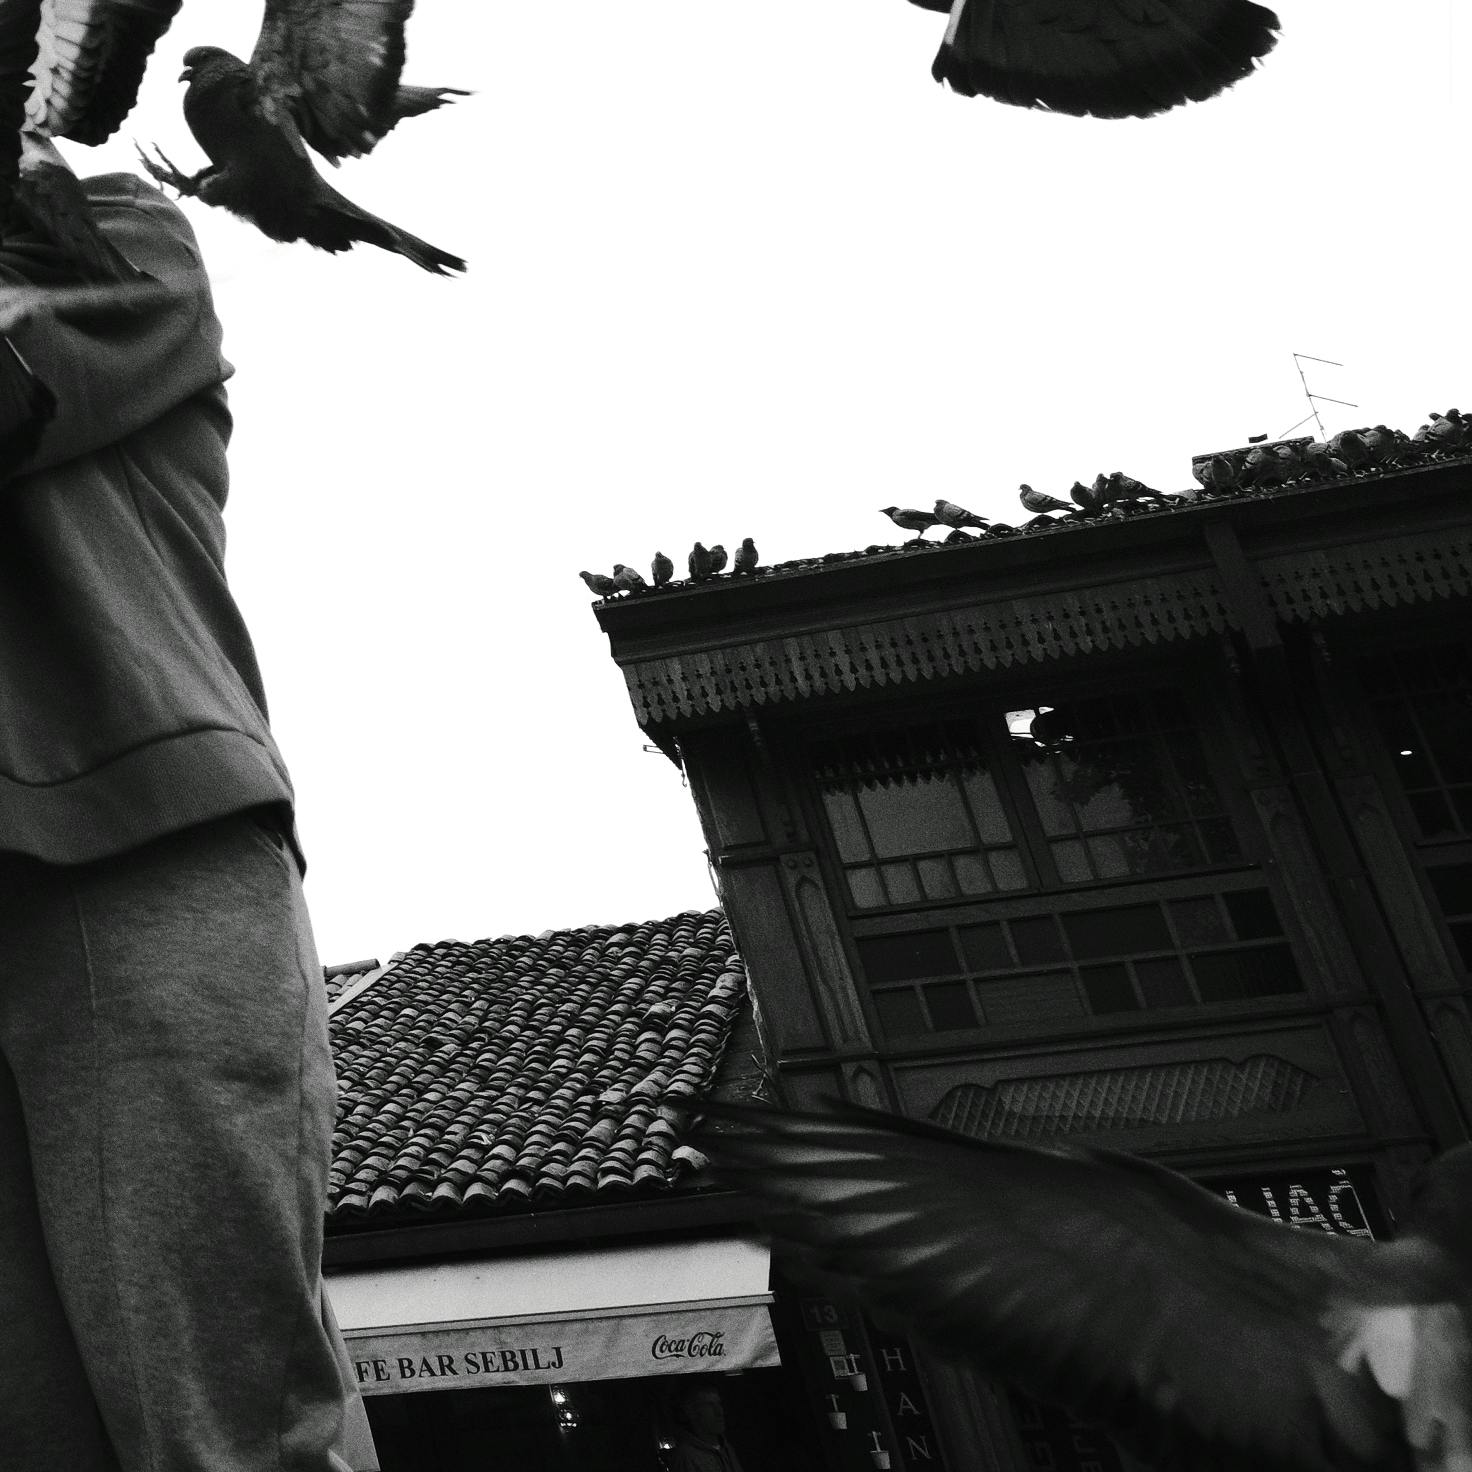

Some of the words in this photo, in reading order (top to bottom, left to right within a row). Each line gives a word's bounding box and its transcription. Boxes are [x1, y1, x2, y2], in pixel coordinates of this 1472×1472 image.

[809, 1304, 838, 1324] 13
[651, 1331, 727, 1360] Coca-Cola
[397, 1353, 458, 1380] BAR
[464, 1346, 565, 1375] SEBILJ
